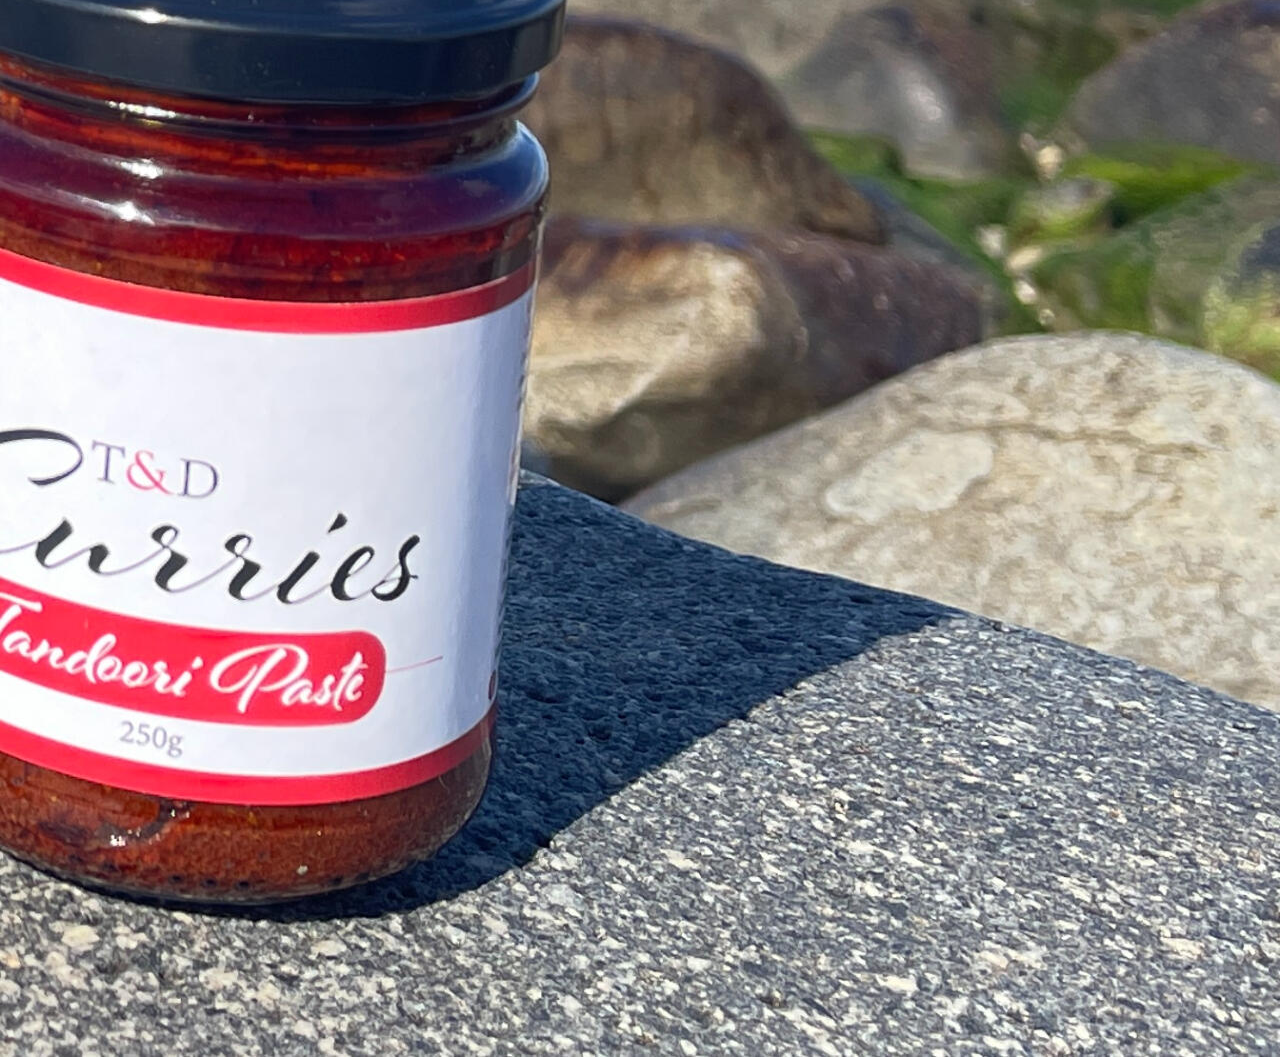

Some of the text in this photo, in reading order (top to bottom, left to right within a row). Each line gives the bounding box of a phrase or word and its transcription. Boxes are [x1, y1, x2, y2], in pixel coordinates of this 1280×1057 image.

[91, 439, 220, 500] T&D
[208, 643, 363, 714] Paste
[118, 720, 185, 759] 250g
